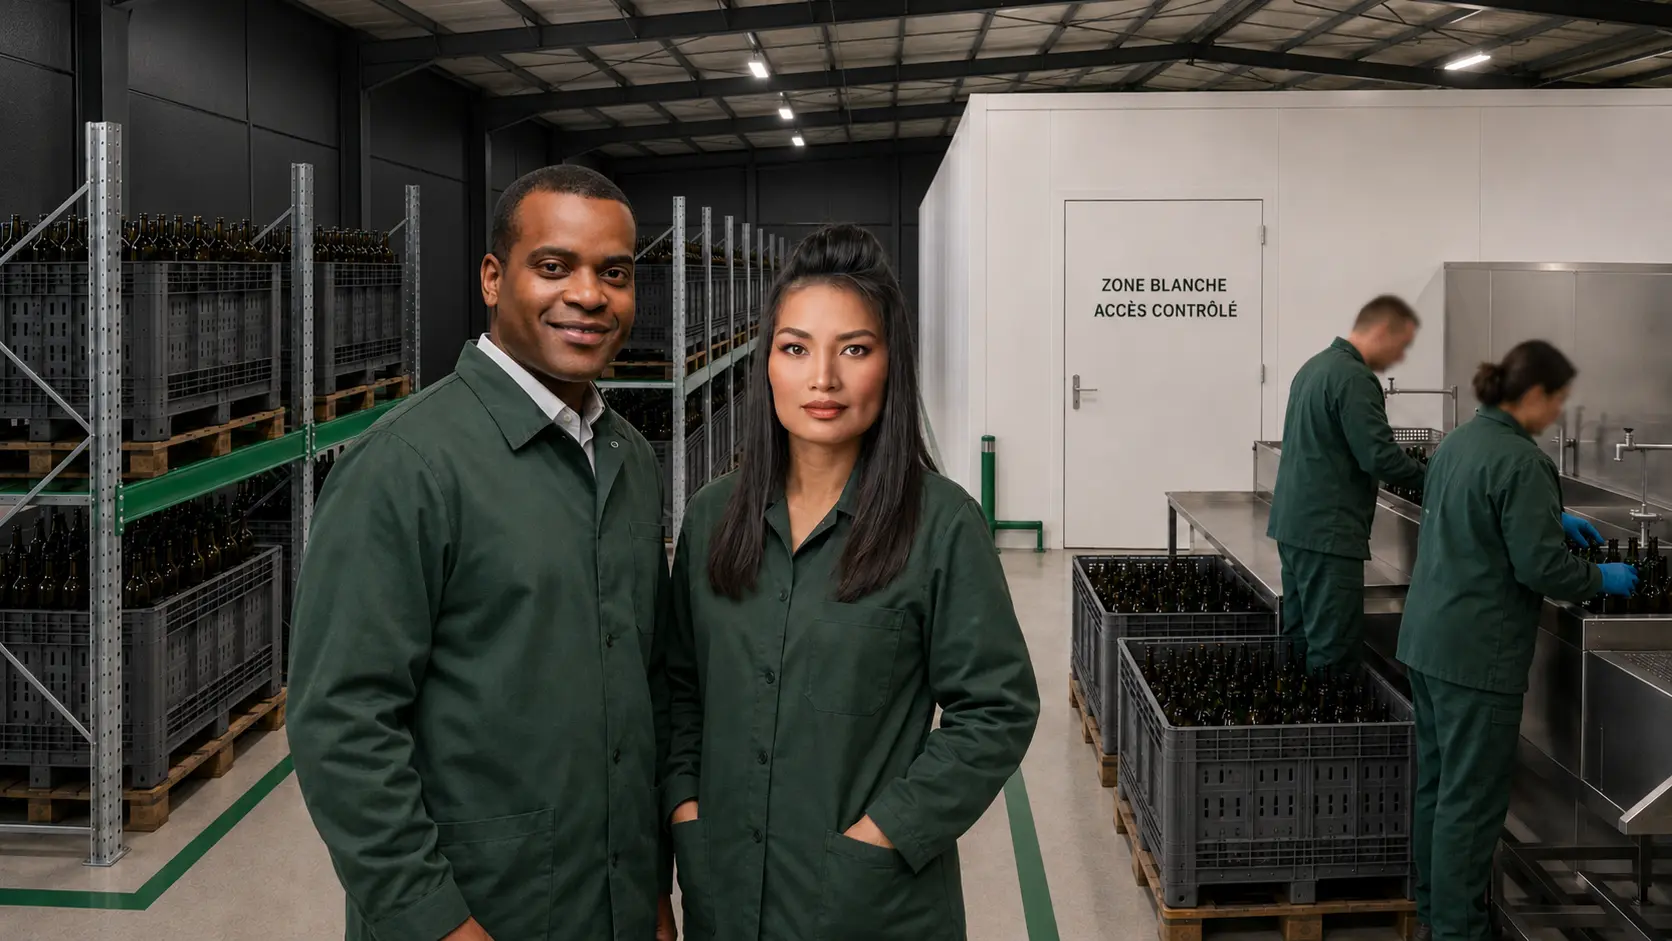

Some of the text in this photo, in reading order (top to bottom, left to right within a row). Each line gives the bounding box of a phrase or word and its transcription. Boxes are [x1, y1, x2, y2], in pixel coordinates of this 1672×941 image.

[1101, 278, 1227, 292] ZONE BLANCHE
[1094, 300, 1238, 317] ACCÈS CONTRÔLÉ
